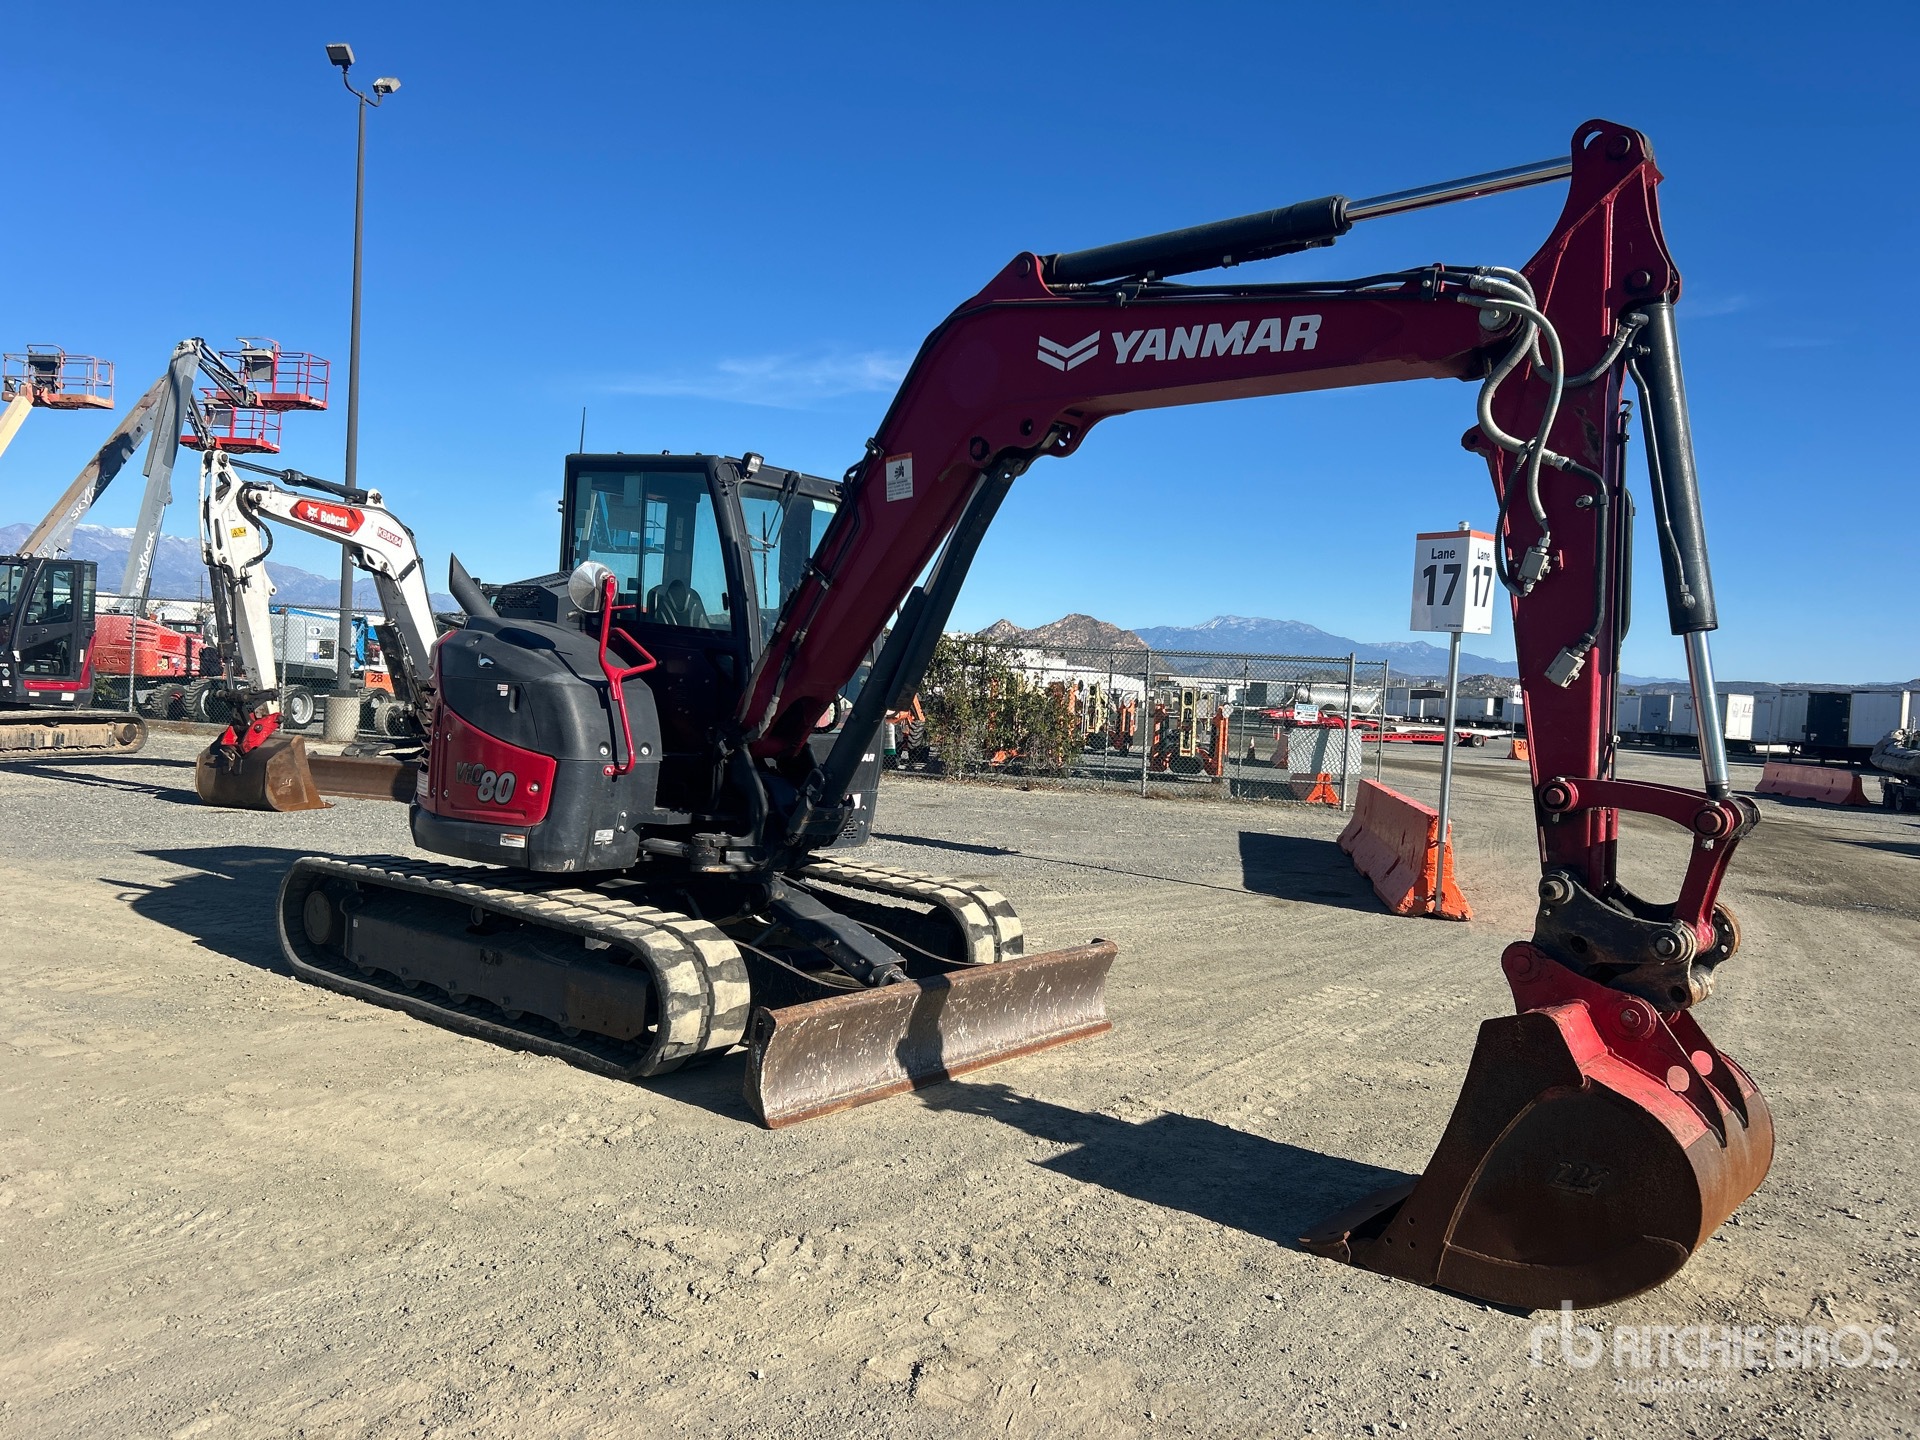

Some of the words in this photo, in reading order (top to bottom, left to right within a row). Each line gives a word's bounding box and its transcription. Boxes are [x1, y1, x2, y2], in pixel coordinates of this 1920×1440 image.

[1112, 314, 1322, 364] YANMAR
[320, 509, 350, 528] Bobcat
[135, 530, 156, 590] SKYJACK
[1431, 547, 1456, 560] Lane
[1477, 548, 1491, 561] Lane
[1423, 563, 1462, 606] 17
[1472, 564, 1493, 608] 17
[370, 674, 383, 683] 28
